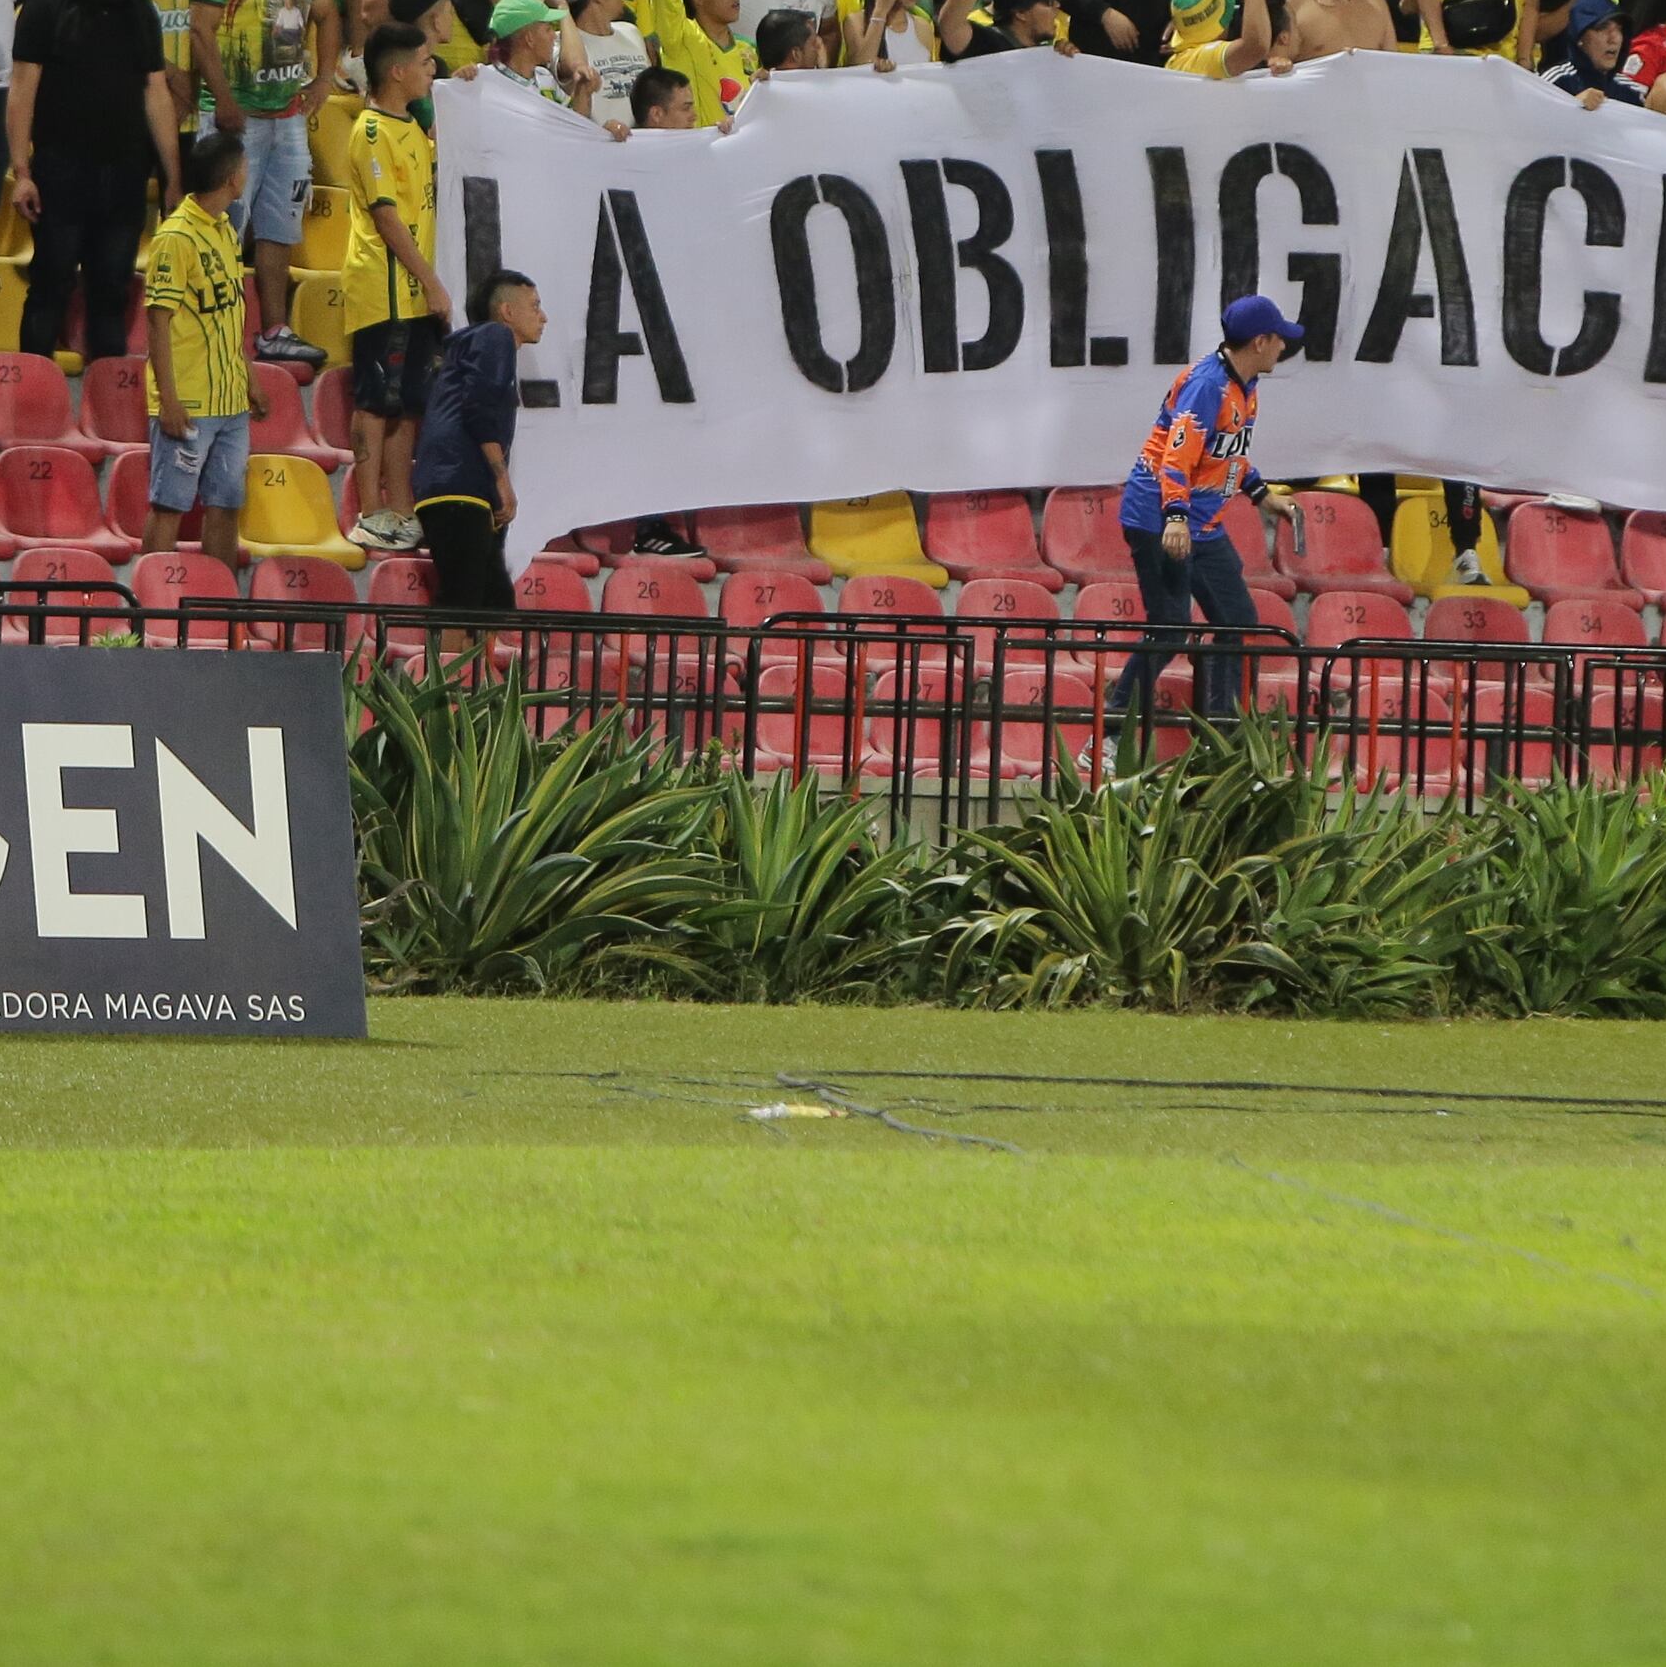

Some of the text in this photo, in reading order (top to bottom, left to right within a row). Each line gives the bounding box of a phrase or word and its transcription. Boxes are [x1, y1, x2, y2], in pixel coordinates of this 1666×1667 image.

[463, 175, 694, 410] LA
[117, 370, 139, 388] 24
[29, 460, 53, 479] 22
[263, 468, 288, 487] 24
[1083, 496, 1104, 515] 31
[1313, 504, 1336, 523] 33
[46, 561, 68, 580] 21
[164, 566, 188, 584] 22
[285, 569, 309, 588] 23
[523, 577, 547, 595] 25
[637, 581, 660, 599] 26
[754, 586, 776, 604] 27
[872, 589, 895, 607] 28
[993, 593, 1016, 612] 29
[1111, 598, 1135, 617] 30
[1343, 606, 1366, 624] 32
[1463, 611, 1486, 629] 33
[1580, 615, 1602, 633] 34
[105, 992, 237, 1022] MAGAVA
[247, 994, 306, 1022] SAS
